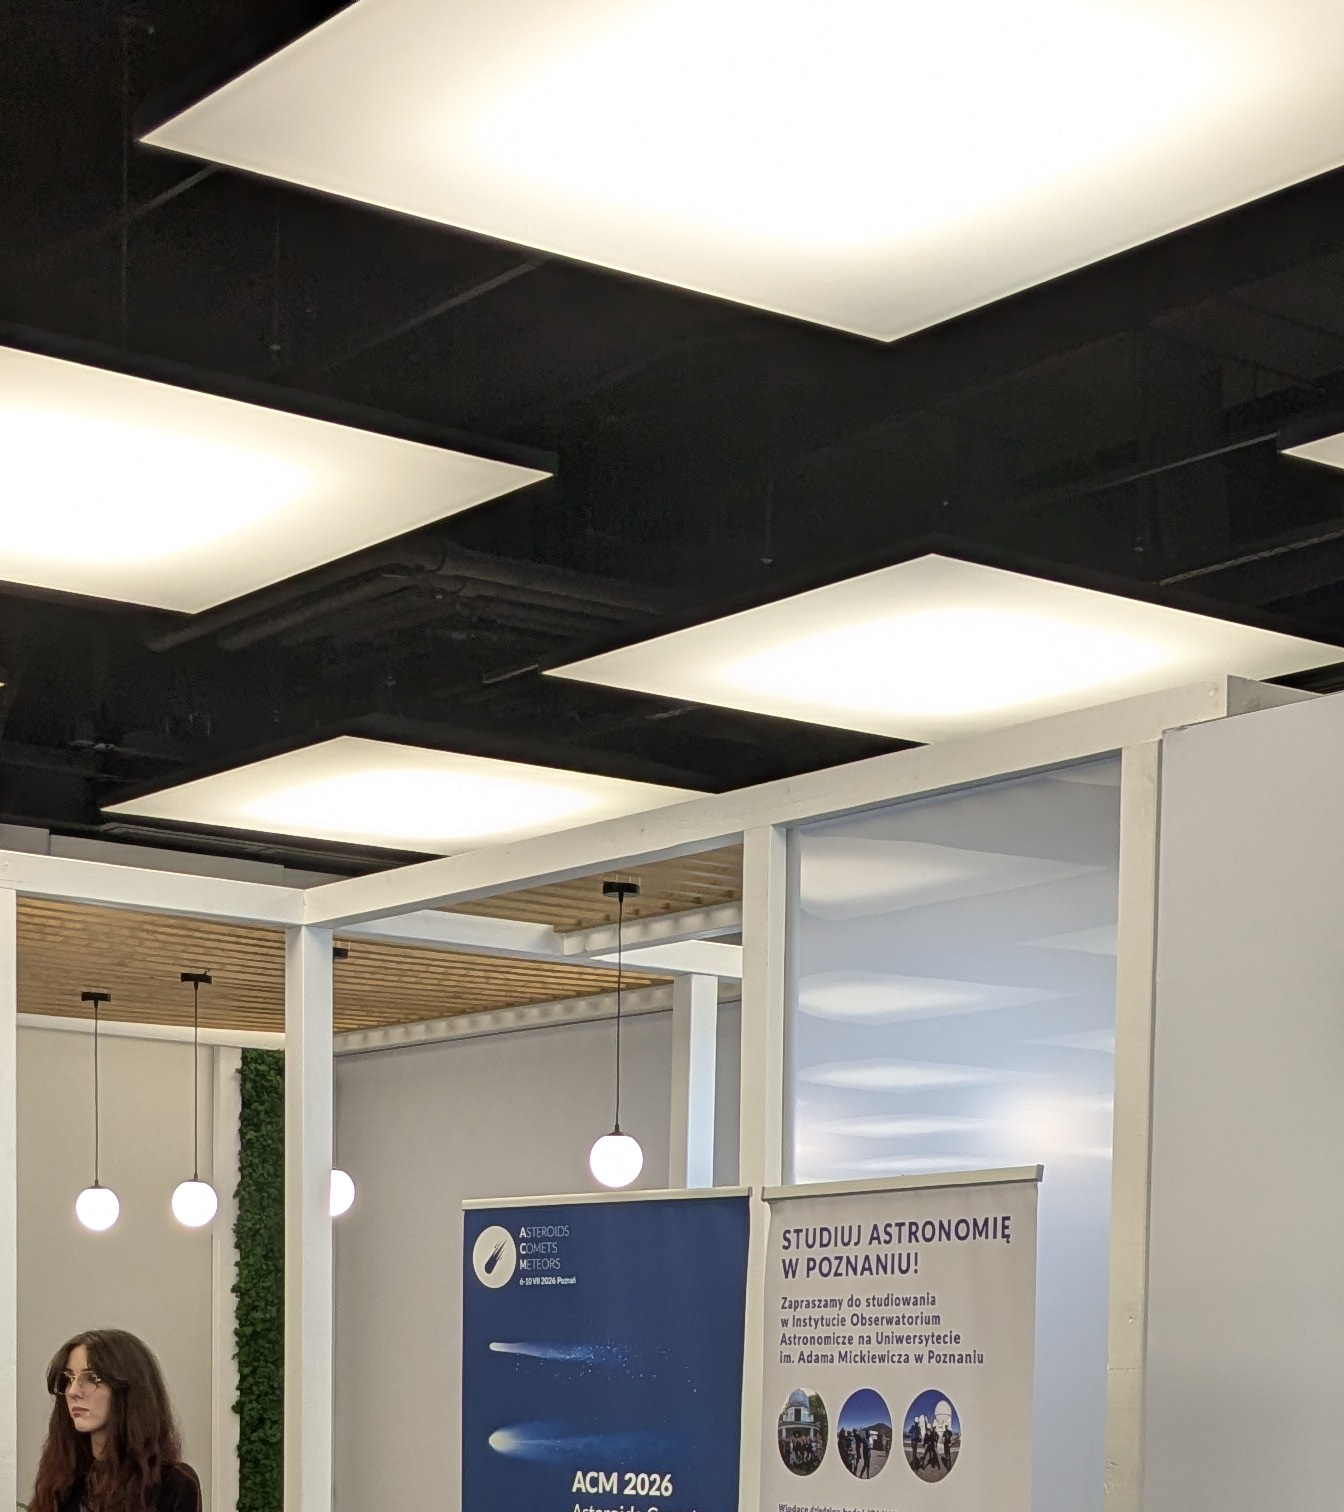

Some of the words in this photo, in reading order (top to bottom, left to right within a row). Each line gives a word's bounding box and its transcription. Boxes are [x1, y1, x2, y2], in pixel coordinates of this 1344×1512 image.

[519, 1225, 570, 1238] ASTEROIDS
[782, 1224, 861, 1250] STUDIUJ
[868, 1216, 1011, 1245] ASTRONOMIĘ
[519, 1242, 558, 1254] COMETS
[519, 1258, 561, 1270] METEORS
[782, 1258, 799, 1279] W
[806, 1252, 919, 1278] POZNANIU!
[781, 1297, 843, 1312] Zapraszamy
[847, 1294, 861, 1307] do
[865, 1292, 936, 1307] studiowania
[781, 1318, 789, 1327] w
[792, 1313, 846, 1330] Instytucie
[850, 1311, 941, 1326] Obserwatorium
[780, 1332, 854, 1345] Astronomicze
[858, 1335, 871, 1345] na
[876, 1330, 961, 1347] Uniwersytecie
[780, 1351, 794, 1363] im.
[798, 1350, 834, 1363] Adama
[838, 1350, 909, 1363] Mickiewicza
[914, 1354, 923, 1363] w
[928, 1349, 984, 1364] Poznaniu
[572, 1471, 618, 1494] ACM
[623, 1473, 673, 1496] 2026
